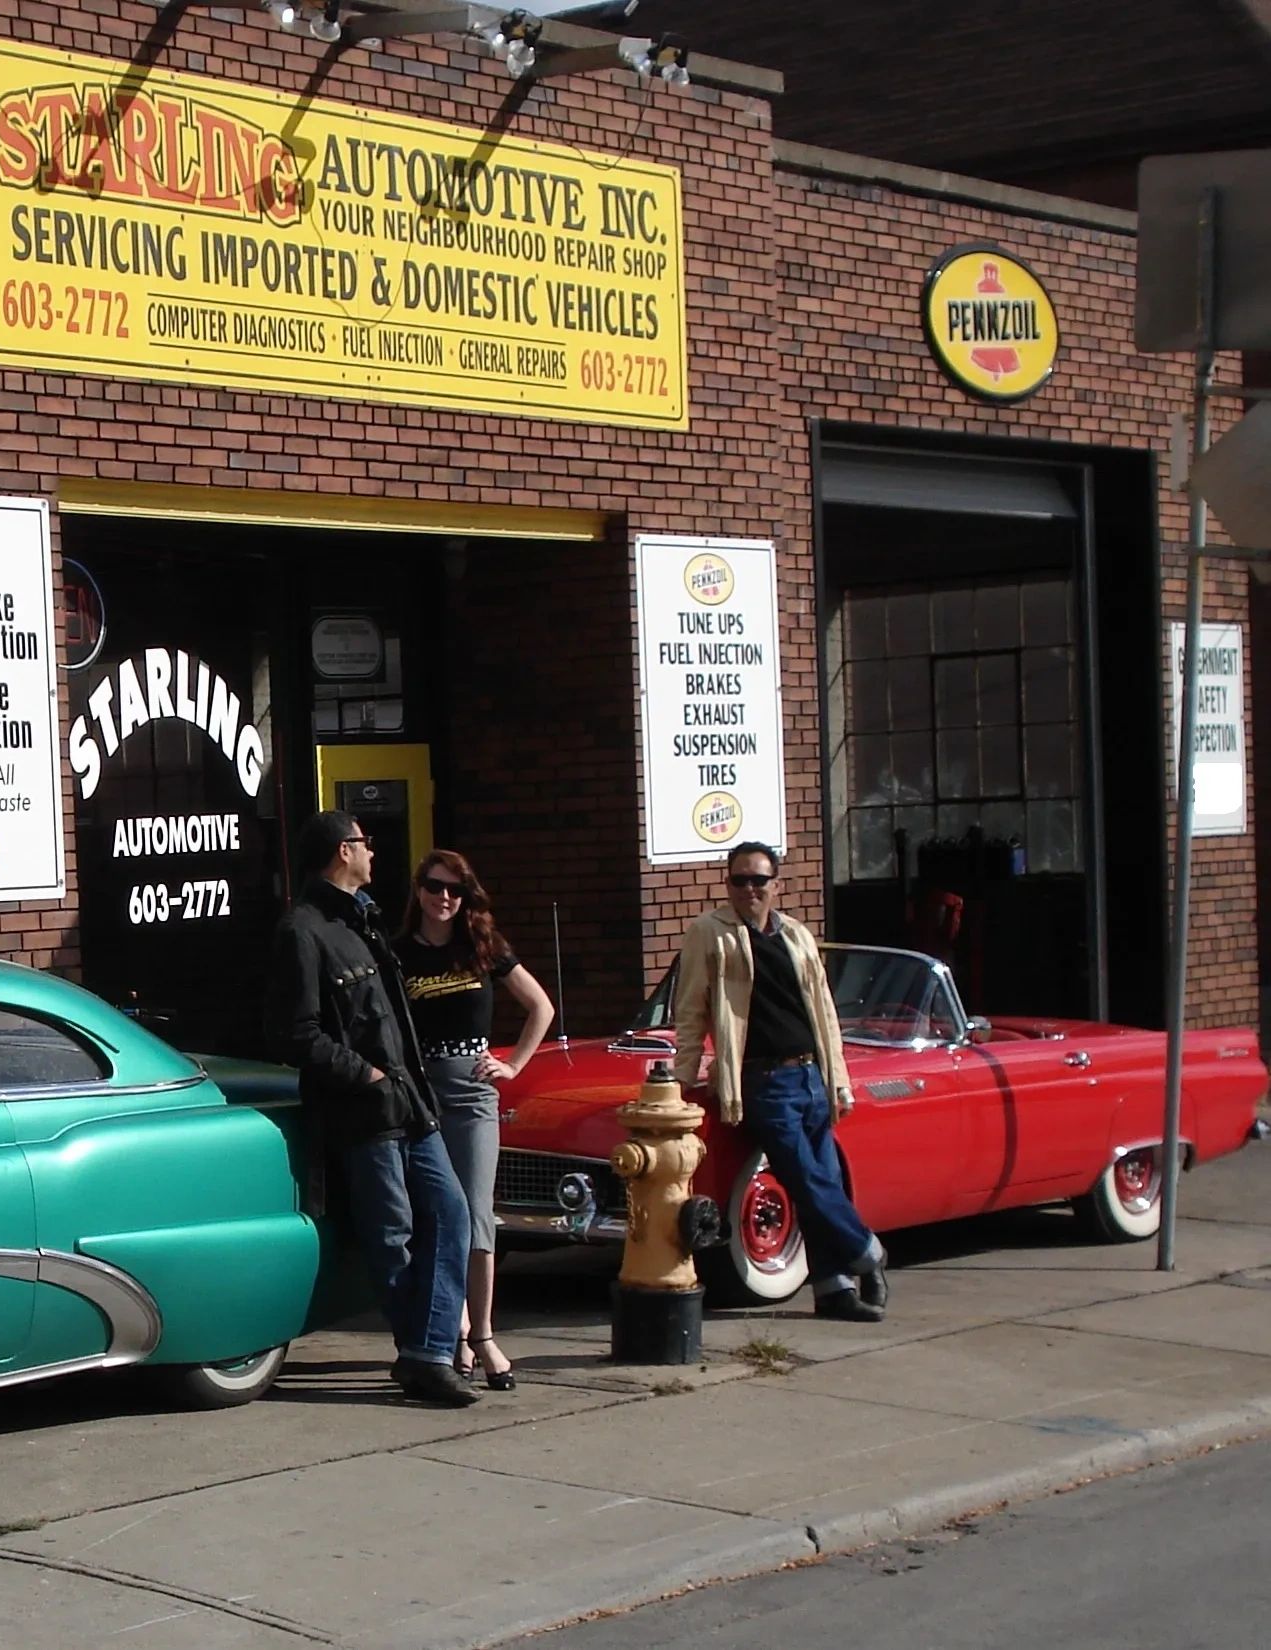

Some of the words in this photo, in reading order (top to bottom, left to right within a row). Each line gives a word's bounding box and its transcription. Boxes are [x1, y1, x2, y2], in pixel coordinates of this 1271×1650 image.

[317, 133, 587, 231] AUTOMOTIVE
[598, 183, 667, 245] INC.
[319, 198, 375, 237] YOUR
[383, 209, 546, 263] NEIGHBOURHOOD
[554, 236, 616, 274] REPAIR
[623, 246, 667, 281] SHOP
[11, 204, 187, 281] SERVICING
[201, 231, 358, 302] IMPORTED
[371, 256, 391, 307] &
[402, 260, 538, 326] DOMESTIC
[546, 280, 659, 340] VEHICLES
[2, 279, 129, 338] 603-2772
[948, 300, 1040, 342] PENNZOIL
[148, 302, 228, 344] COMPUTER
[234, 314, 326, 353] DIAGNOSTICS
[342, 325, 374, 360] FUEL
[378, 329, 443, 366] INJECTION
[459, 338, 513, 374] GENERAL
[517, 346, 567, 380] REPAIRS
[581, 349, 668, 397] 603-2772
[691, 566, 728, 589] PENNZOIL
[678, 612, 713, 635] TUNE
[718, 613, 744, 635] UPS
[659, 642, 694, 665] FUEL
[698, 642, 763, 665] INJECTION
[686, 674, 742, 696] BRAKES
[1198, 685, 1227, 714] AFETY
[69, 647, 264, 801] STARLING
[684, 703, 745, 726] EXHAUST
[673, 733, 757, 757] SUSPENSION
[698, 764, 737, 787] TIRES
[112, 814, 240, 858] AUTOMOTIVE
[128, 879, 231, 925] 603-2772
